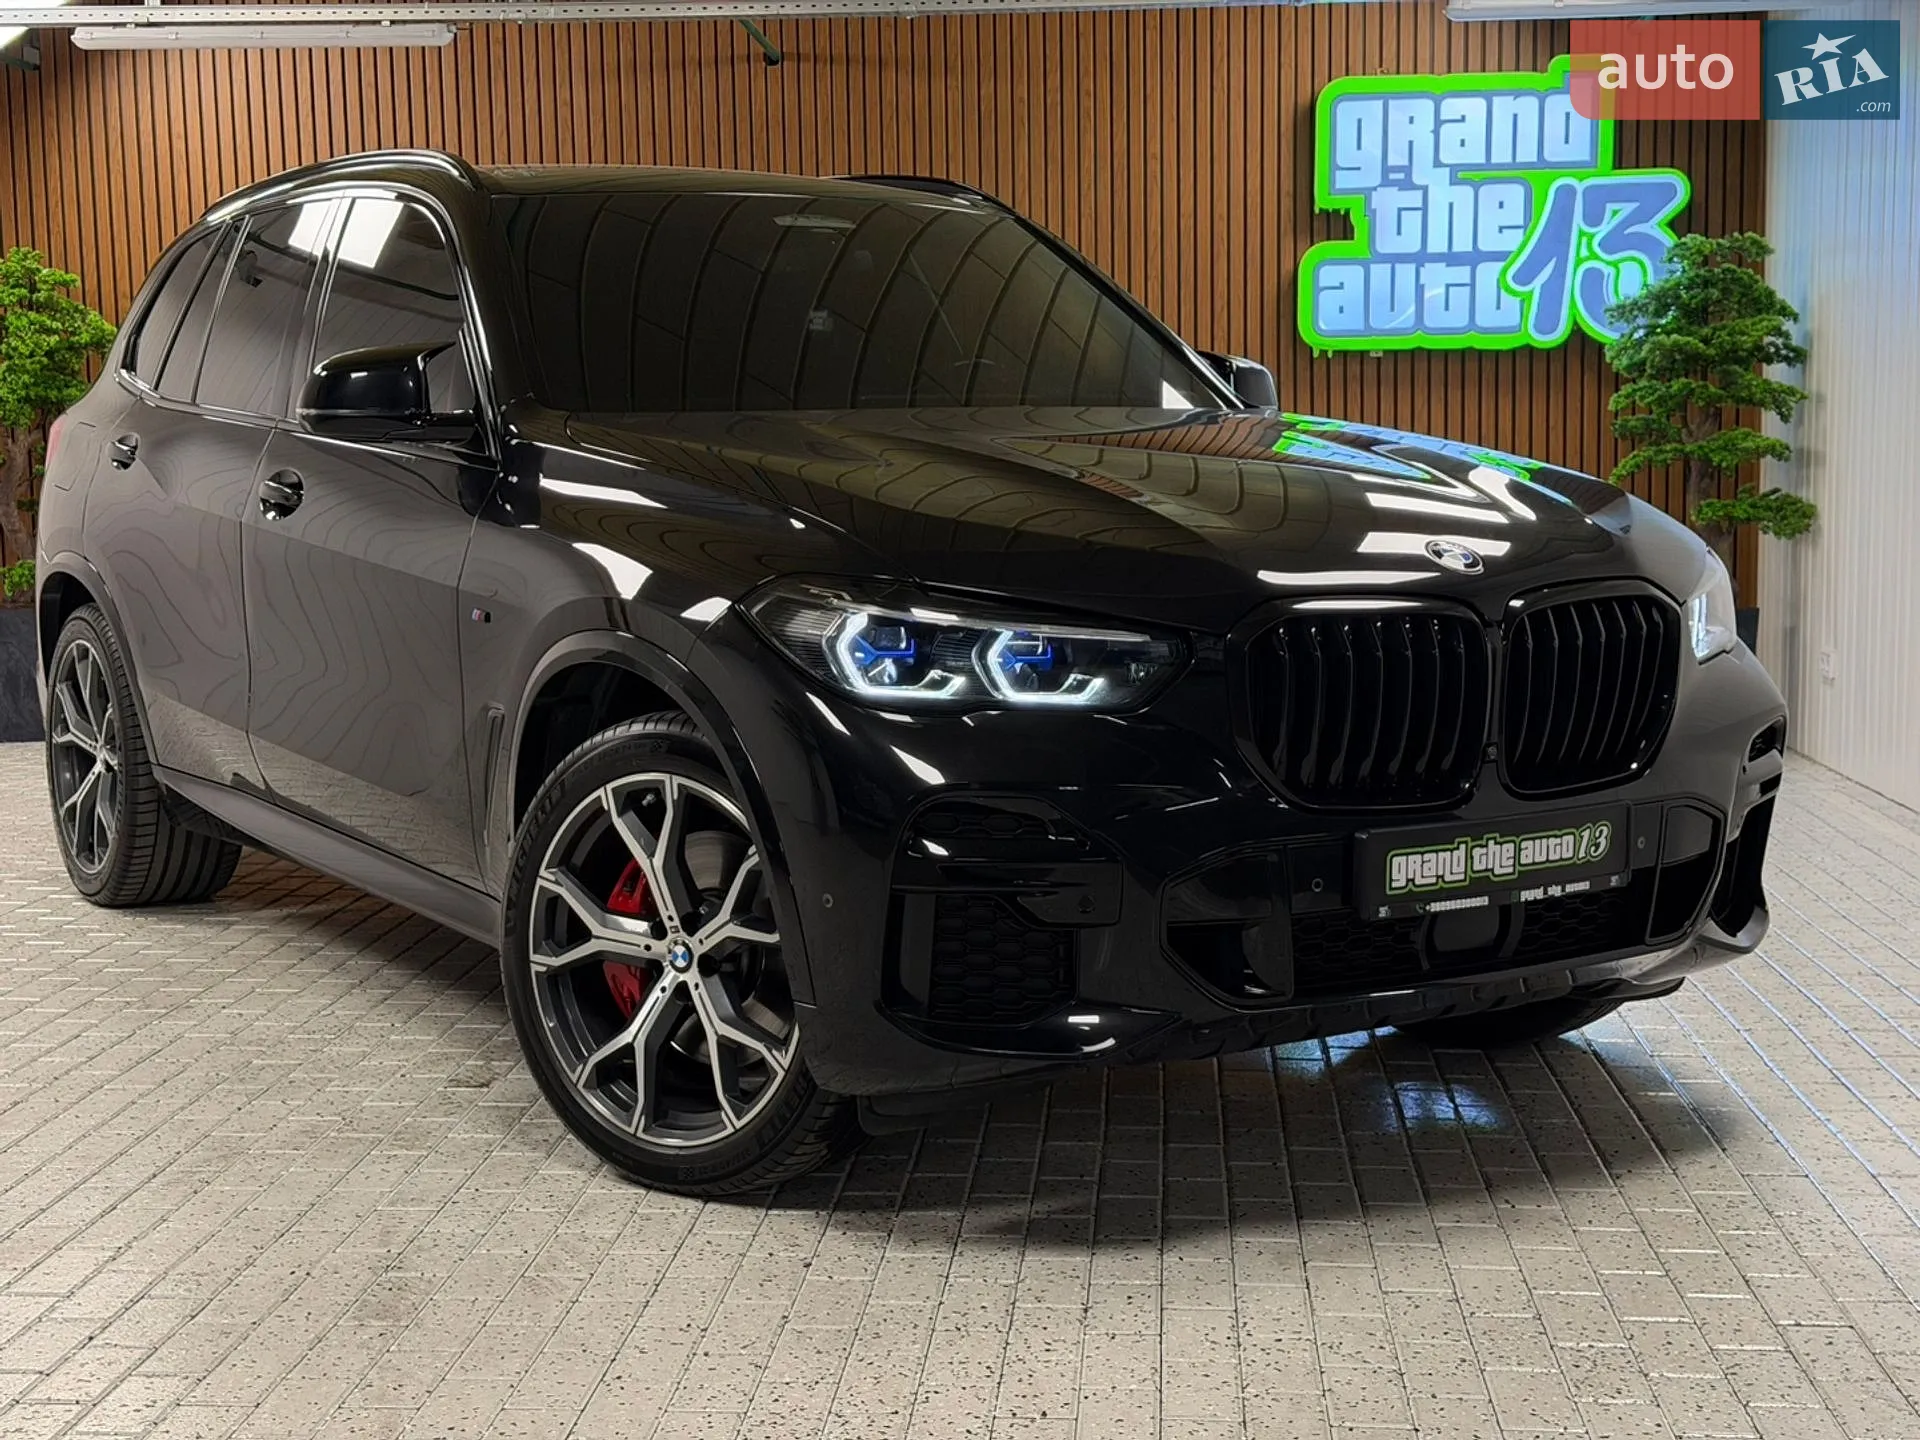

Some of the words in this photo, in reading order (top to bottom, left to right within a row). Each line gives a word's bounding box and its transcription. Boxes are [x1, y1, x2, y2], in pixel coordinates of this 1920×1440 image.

[1371, 166, 1526, 255] the
[1317, 260, 1524, 331] auto
[1506, 175, 1682, 341] 13
[1472, 839, 1515, 876] the
[1521, 834, 1574, 865] auto
[1576, 826, 1608, 860] 13
